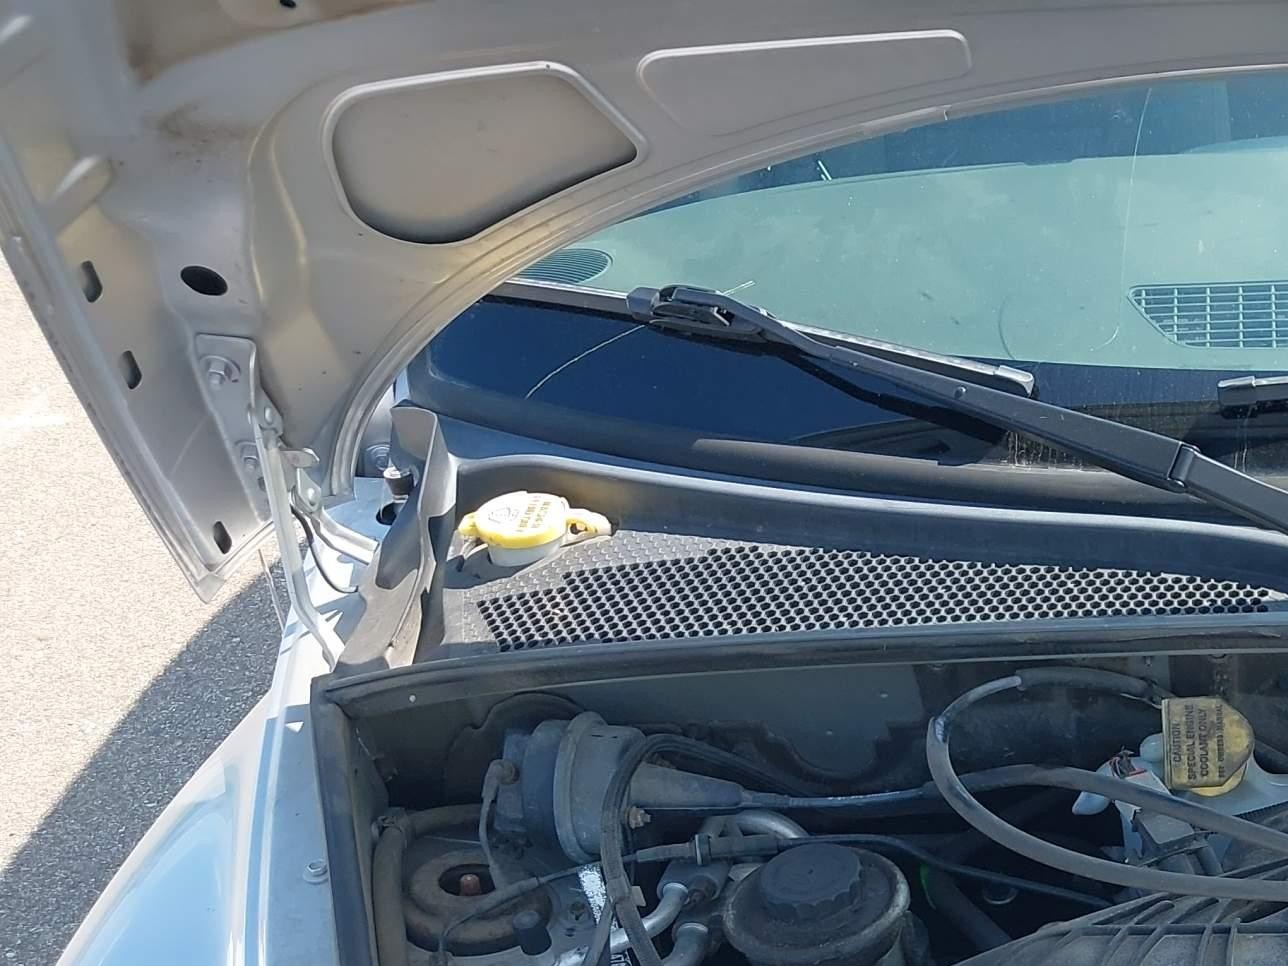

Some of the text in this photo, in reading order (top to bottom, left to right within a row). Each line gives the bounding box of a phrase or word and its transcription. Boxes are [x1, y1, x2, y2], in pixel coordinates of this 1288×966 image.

[1172, 723, 1182, 763] CAUTION
[1187, 741, 1197, 780] SPECIAL
[1198, 708, 1209, 777] COOLANT ONLY
